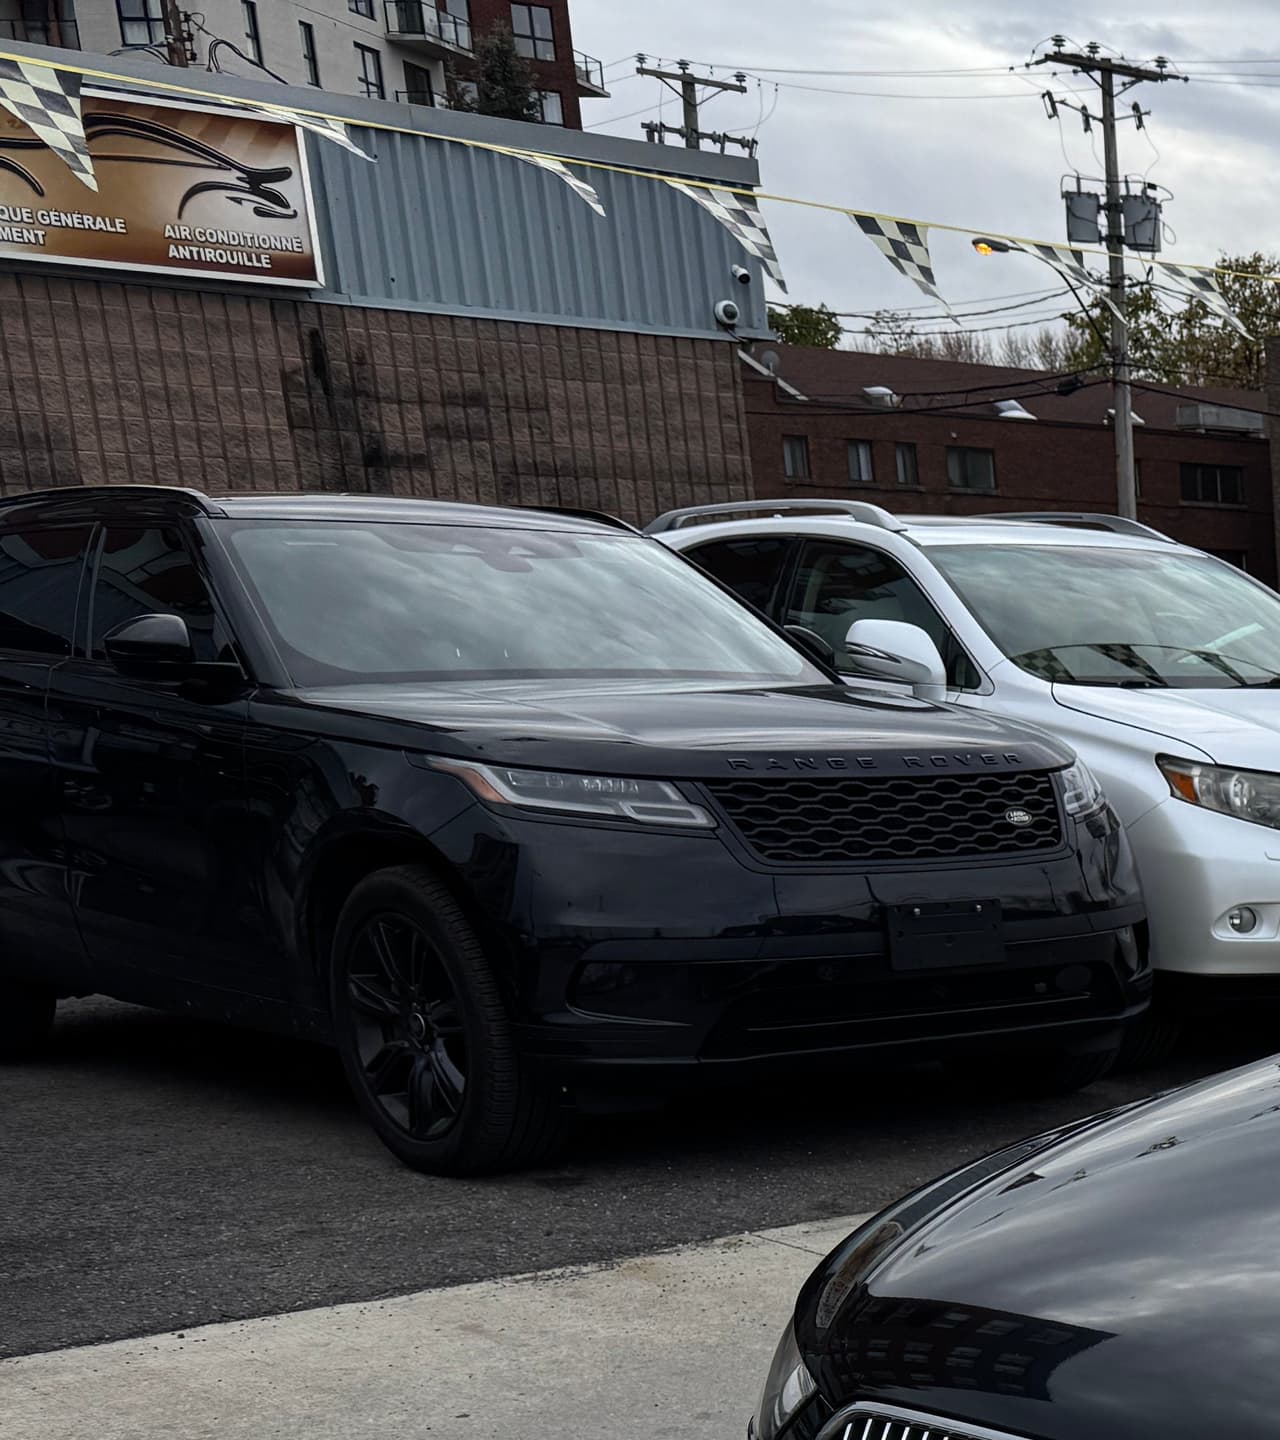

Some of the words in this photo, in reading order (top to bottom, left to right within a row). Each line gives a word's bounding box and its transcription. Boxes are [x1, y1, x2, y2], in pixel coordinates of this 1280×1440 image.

[37, 209, 127, 233] GÉNÉRALE
[164, 224, 192, 241] AIR
[195, 227, 303, 253] CONDITIONNÉ
[168, 244, 273, 269] ANTIROUILLE
[726, 757, 878, 772] RANGE
[902, 752, 1022, 769] ROVER
